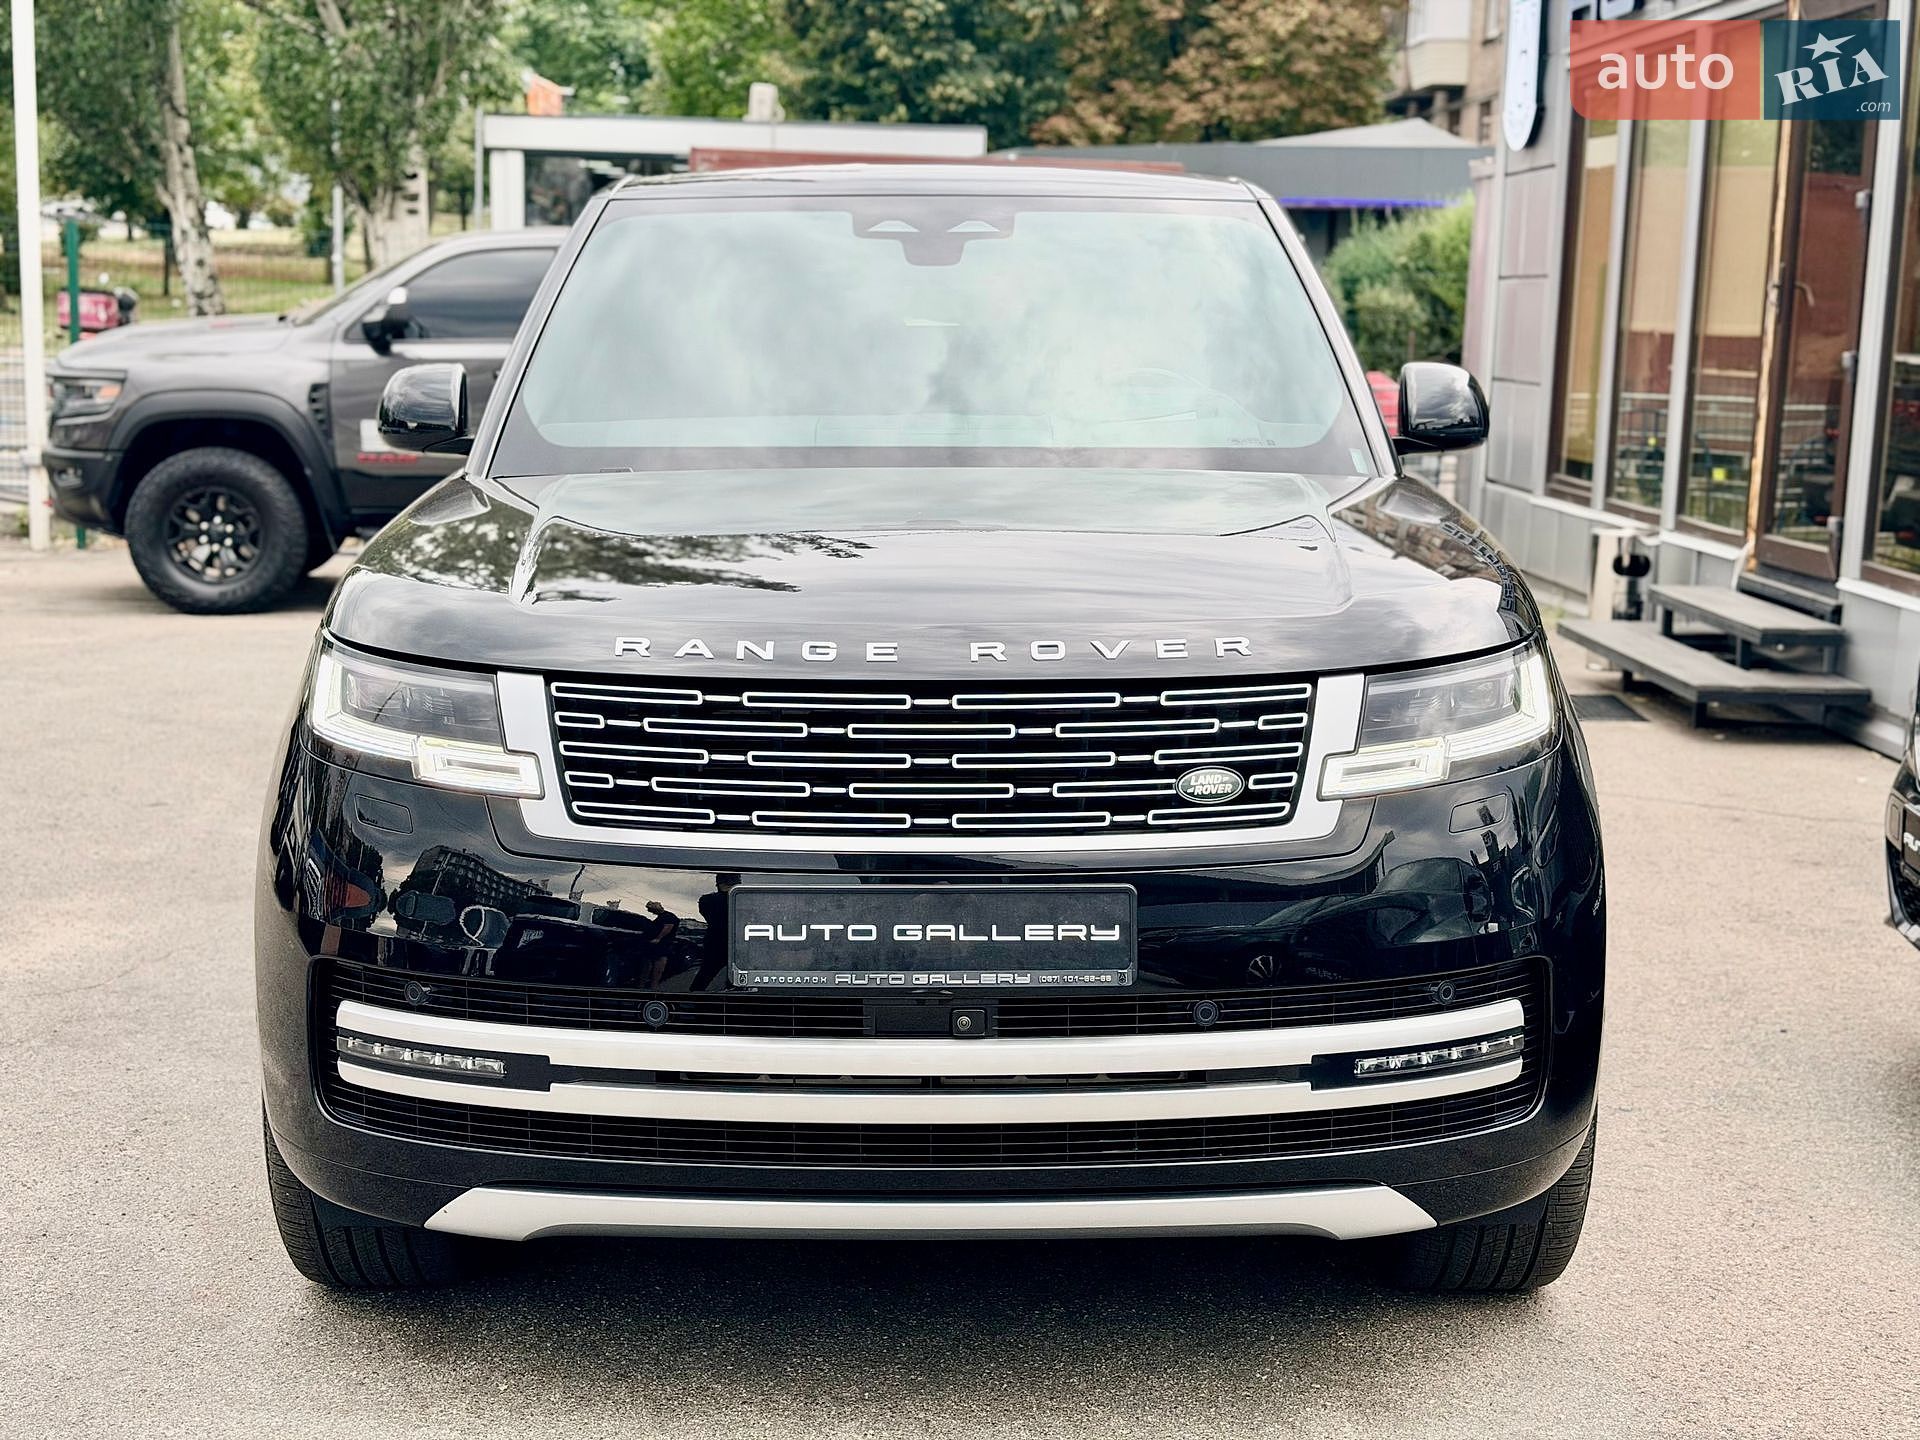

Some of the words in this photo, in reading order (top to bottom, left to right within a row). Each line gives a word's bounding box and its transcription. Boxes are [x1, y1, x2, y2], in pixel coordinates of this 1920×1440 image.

[614, 635, 900, 662] RANGE
[969, 635, 1254, 662] ROVER
[1190, 774, 1221, 785] LAND
[1194, 784, 1232, 795] ROVER
[744, 924, 878, 941] AUTO
[892, 924, 1120, 941] GALLERY
[834, 973, 905, 985] AUTO
[911, 973, 1031, 985] GALLERY
